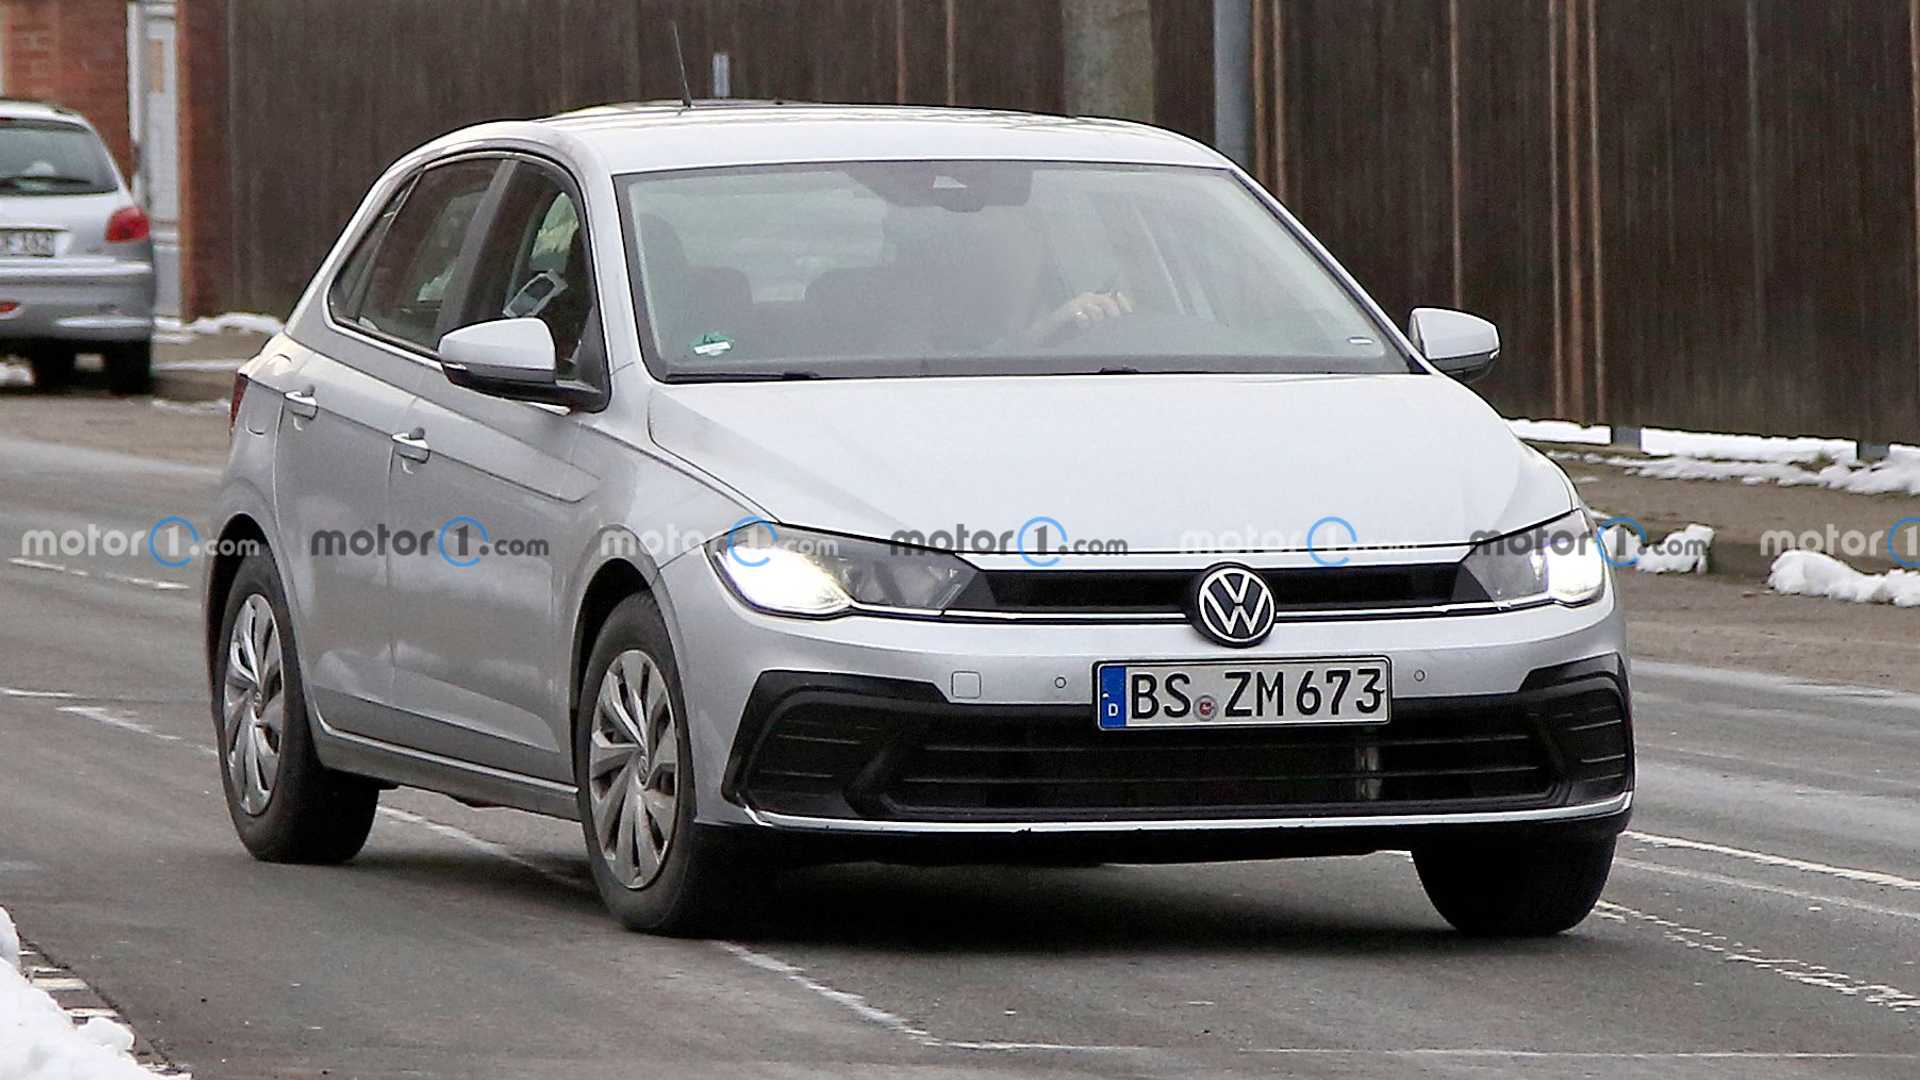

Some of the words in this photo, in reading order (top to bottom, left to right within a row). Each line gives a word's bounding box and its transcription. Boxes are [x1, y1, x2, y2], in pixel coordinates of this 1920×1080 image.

[1107, 703, 1119, 716] D
[1131, 672, 1191, 720] BS
[1224, 671, 1284, 718] ZM
[1296, 668, 1383, 716] 673
